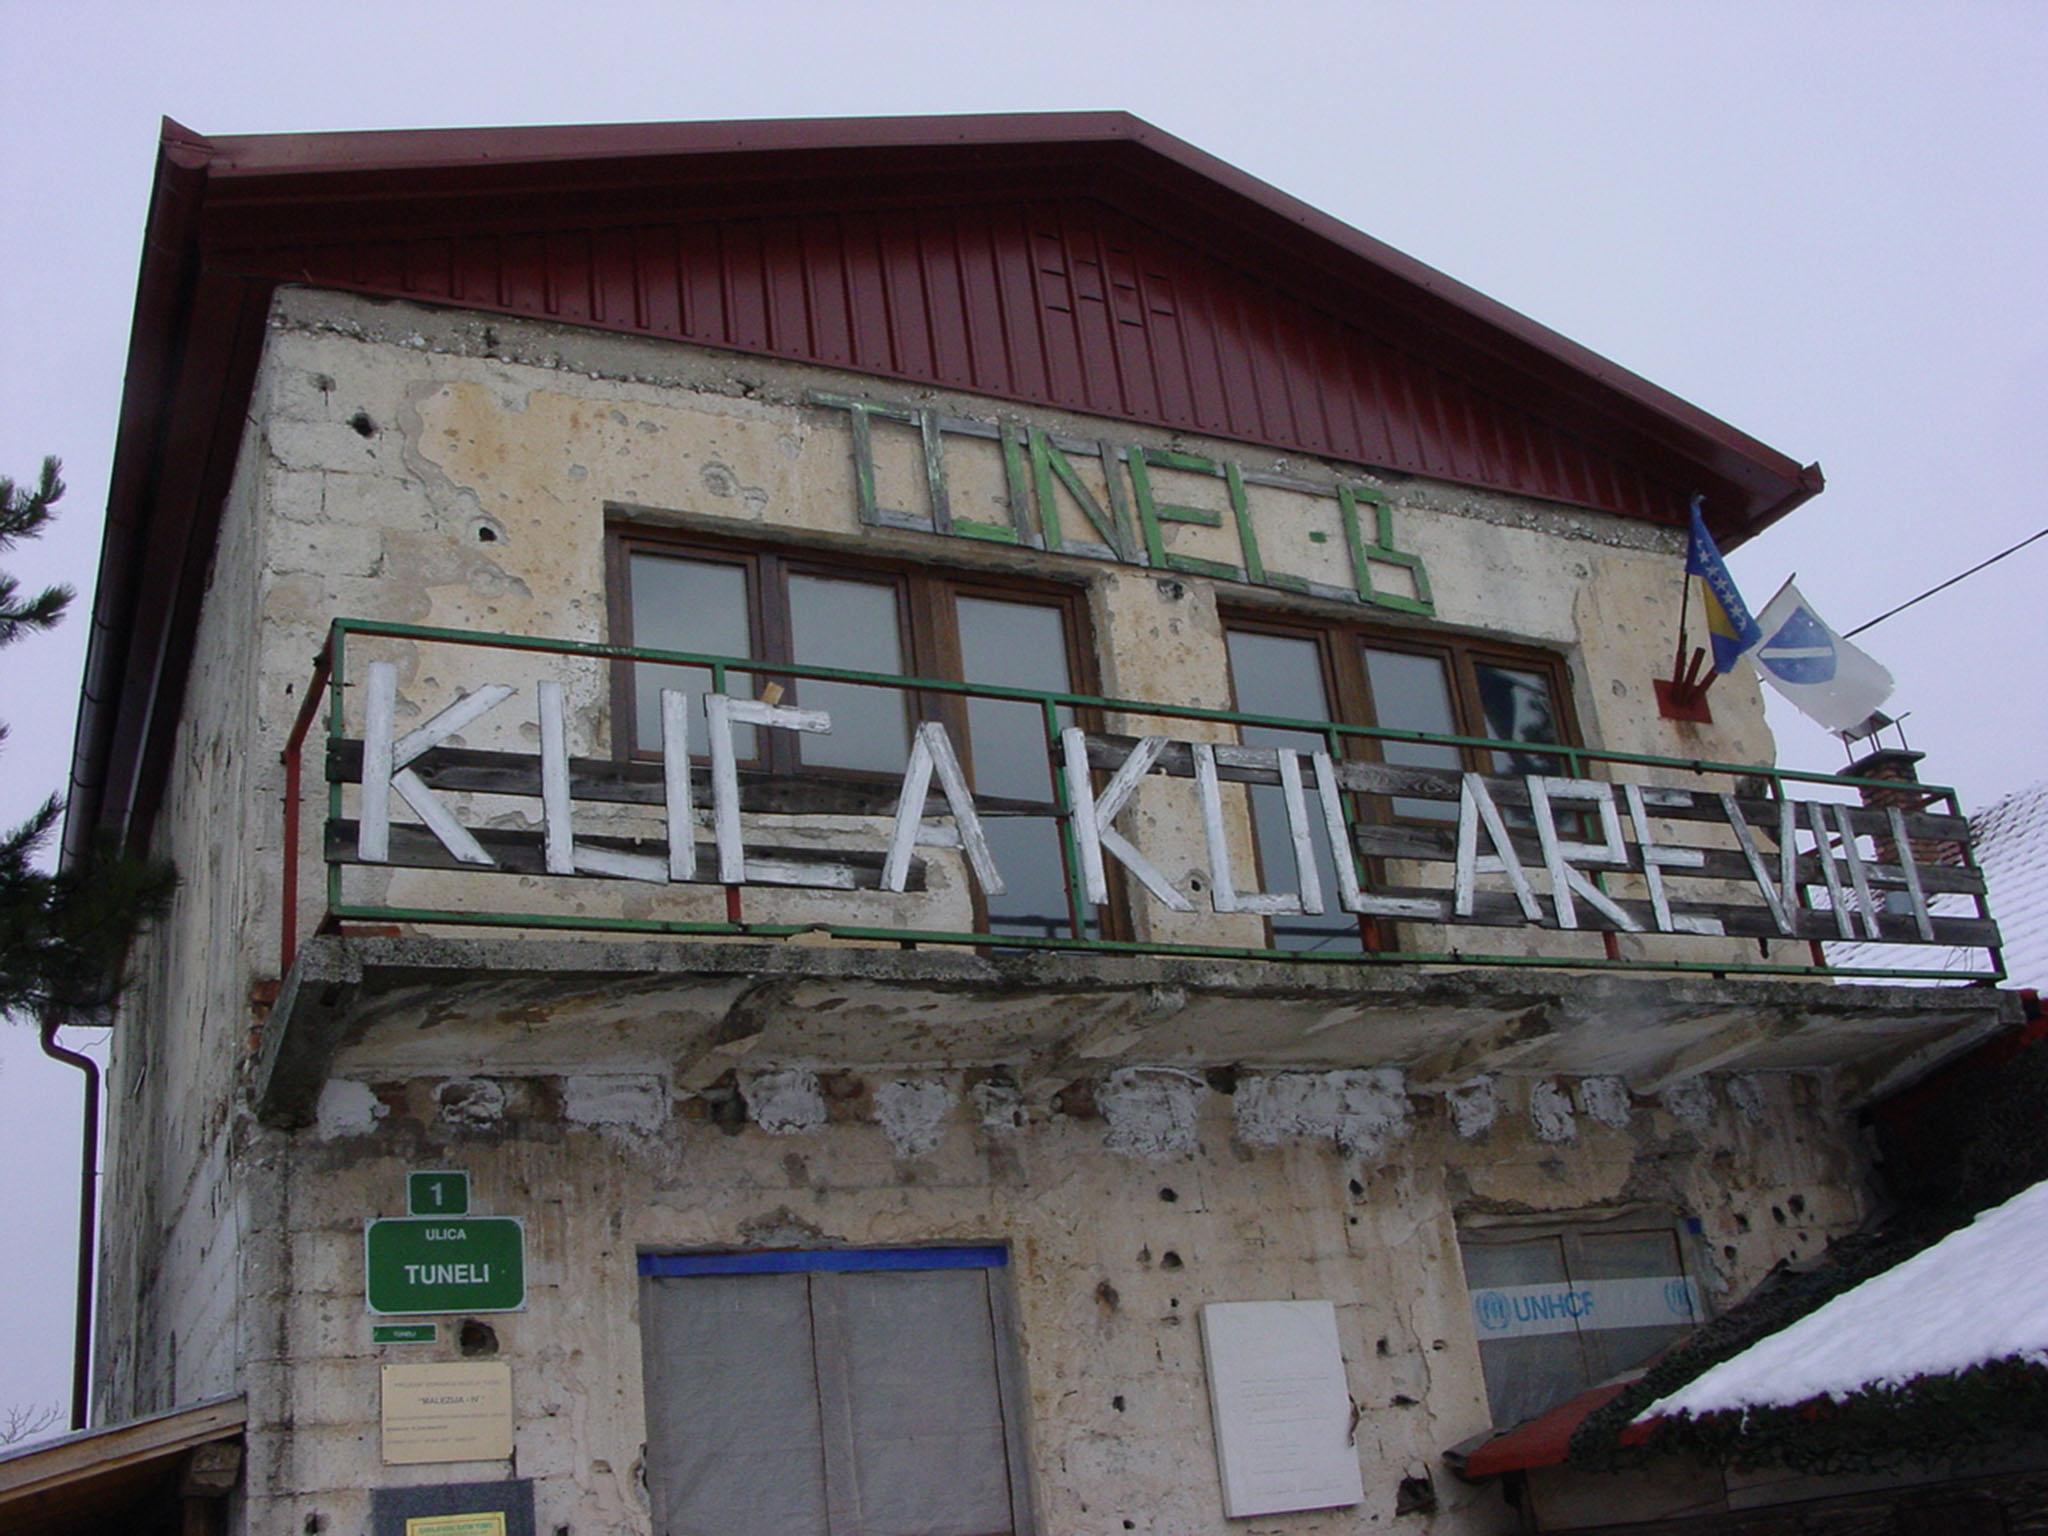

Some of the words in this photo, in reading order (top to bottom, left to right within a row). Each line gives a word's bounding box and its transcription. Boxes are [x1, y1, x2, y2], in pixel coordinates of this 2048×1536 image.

[429, 1182, 443, 1206] 1
[425, 1228, 467, 1241] ULICA
[403, 1264, 490, 1285] TUNELI
